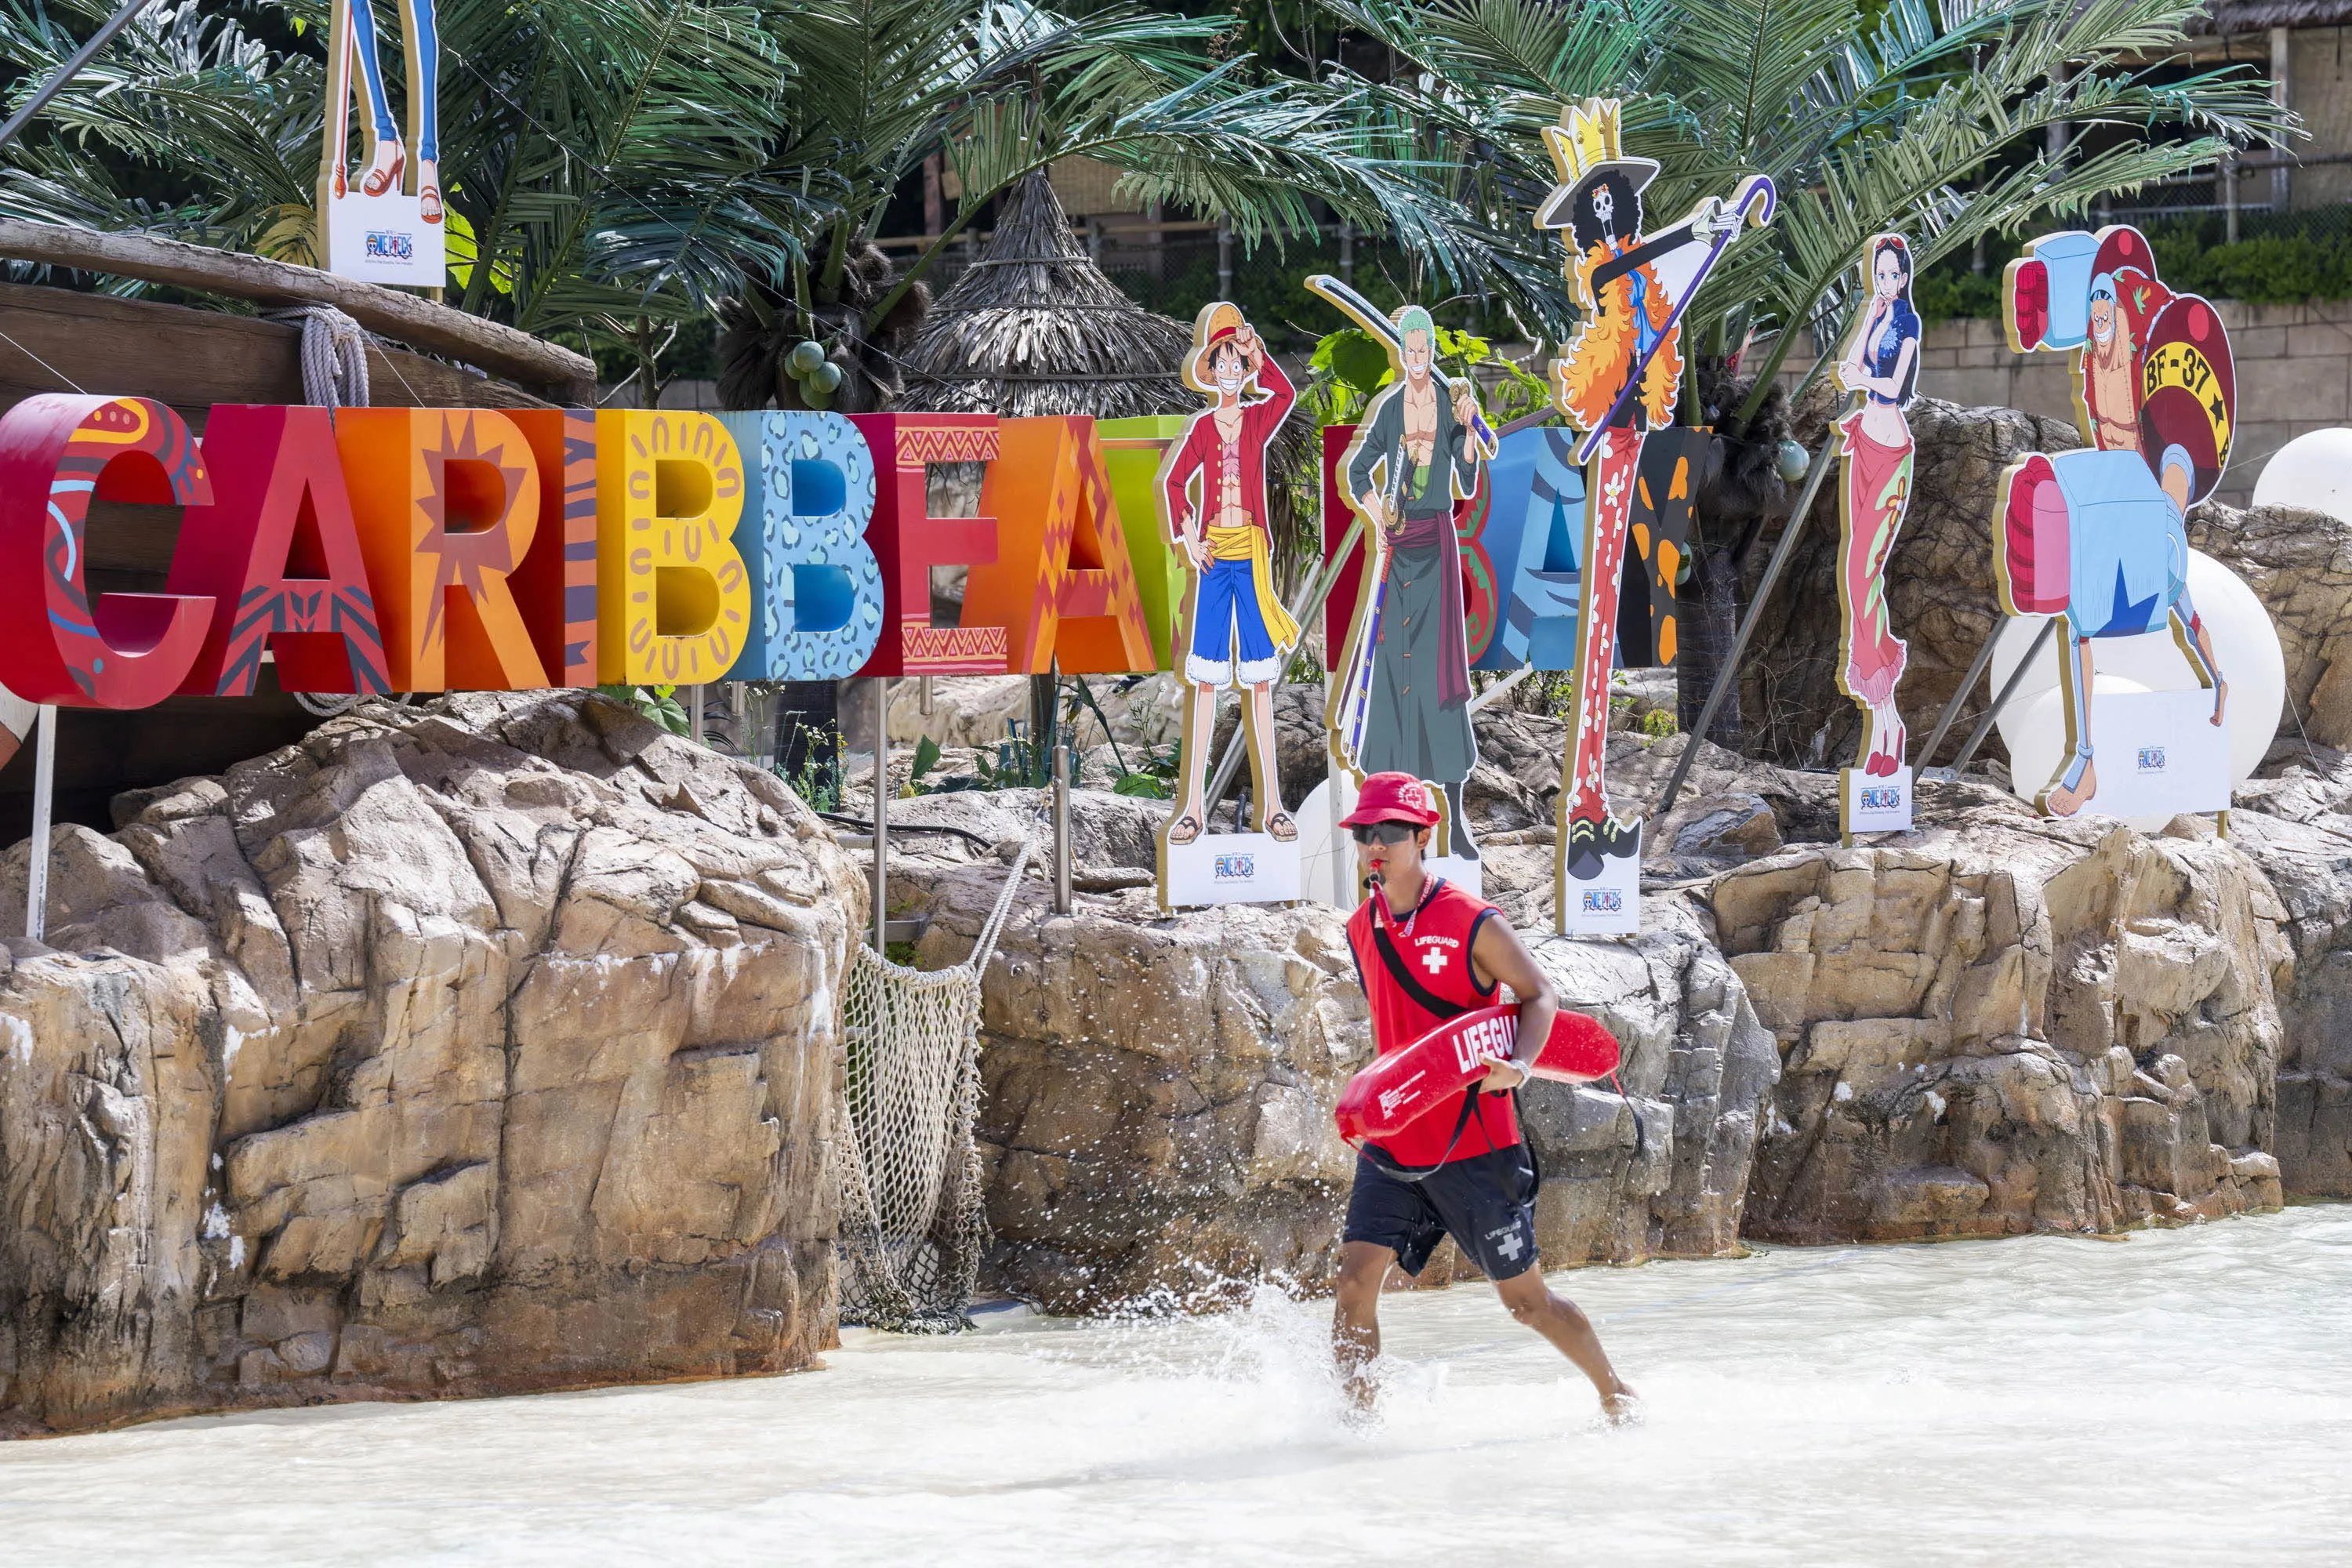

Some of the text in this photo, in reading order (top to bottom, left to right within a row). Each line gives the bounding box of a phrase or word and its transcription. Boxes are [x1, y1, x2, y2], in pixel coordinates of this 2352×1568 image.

[366, 234, 388, 255] ONE
[0, 394, 1188, 710] CARIBBEA
[1414, 935, 1459, 949] LIFEGUARD
